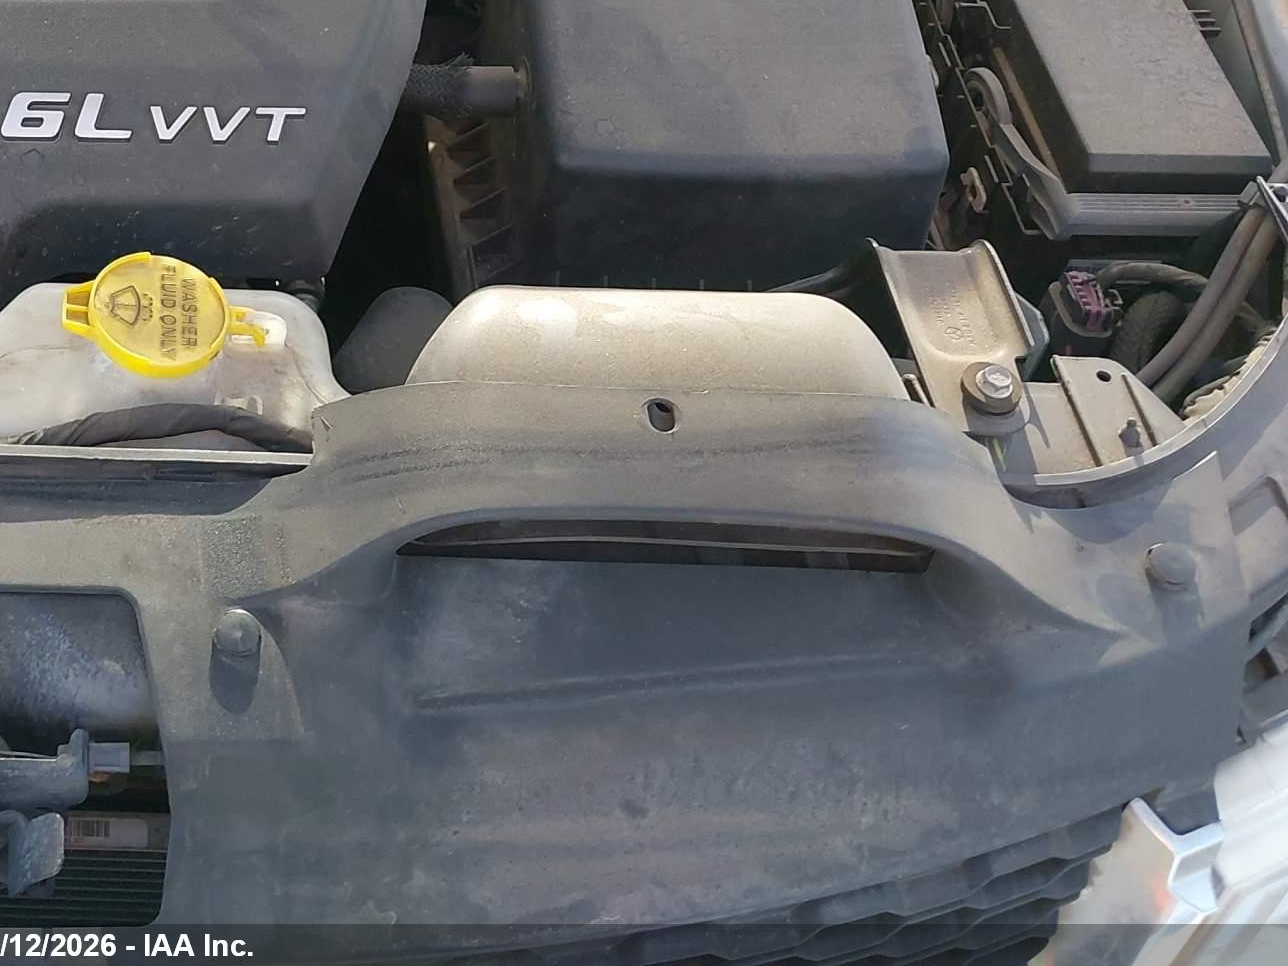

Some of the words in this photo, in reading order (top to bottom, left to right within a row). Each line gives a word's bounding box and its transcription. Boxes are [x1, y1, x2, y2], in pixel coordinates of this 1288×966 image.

[149, 105, 307, 144] VVT
[160, 264, 177, 314] FLUID
[181, 277, 198, 348] WASHER
[159, 314, 177, 361] ONLY
